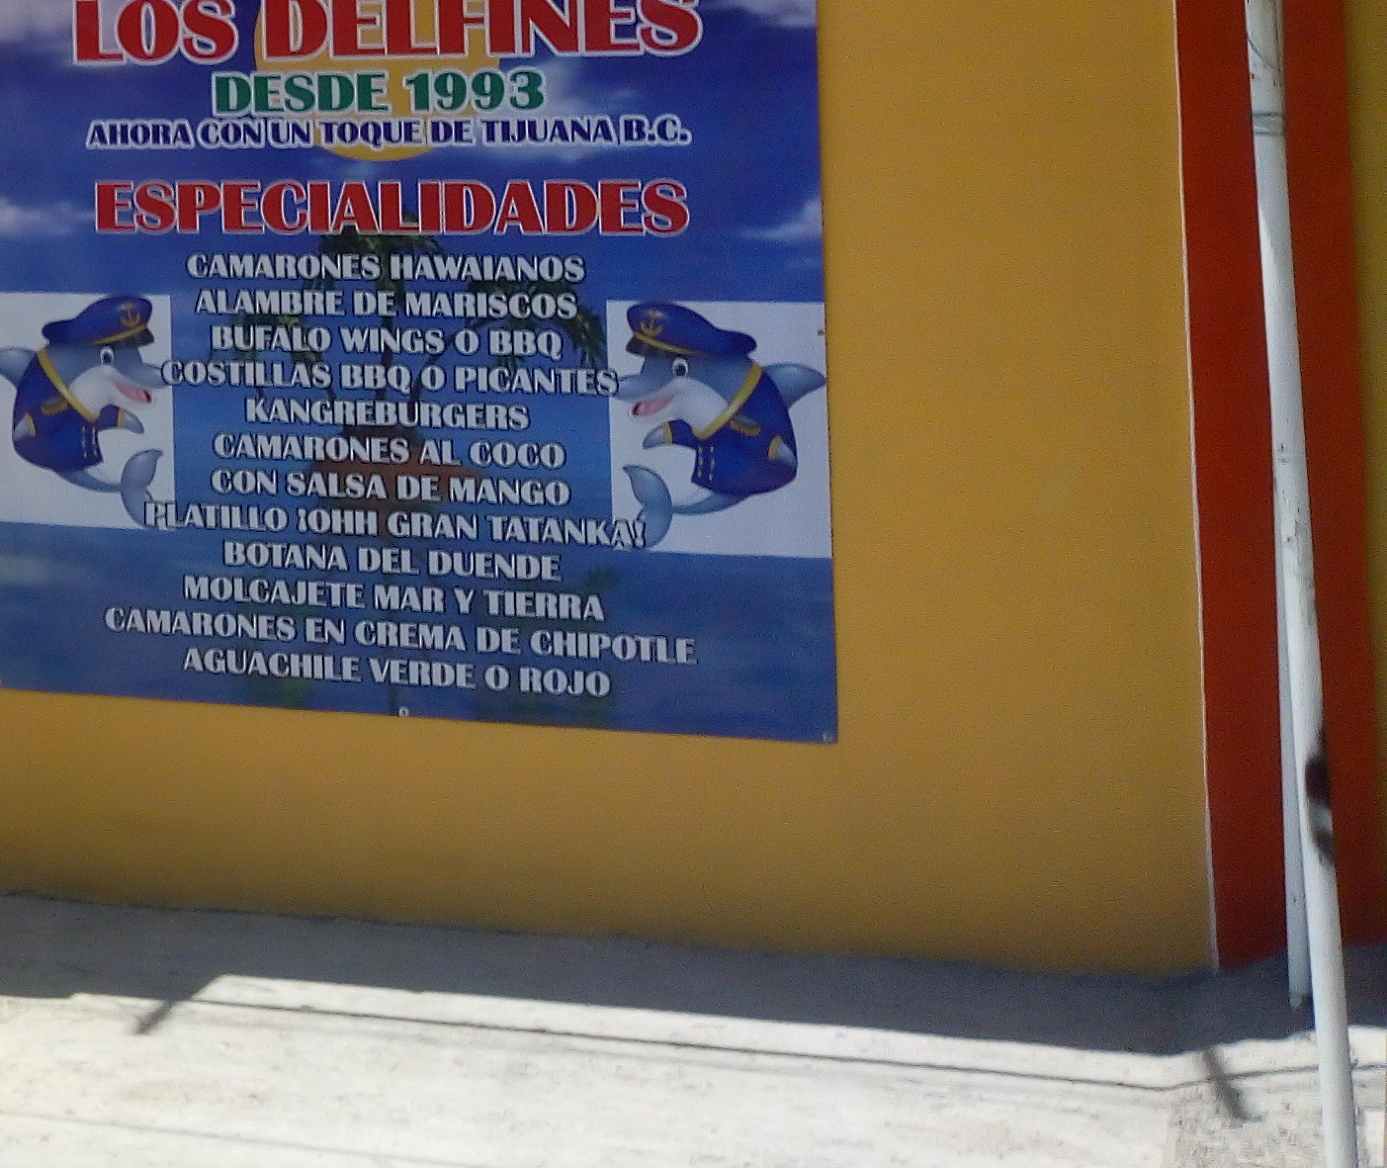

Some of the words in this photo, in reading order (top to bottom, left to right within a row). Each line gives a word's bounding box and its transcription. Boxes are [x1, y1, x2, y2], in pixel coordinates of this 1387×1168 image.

[213, 71, 389, 116] DESDE
[406, 69, 544, 112] 1993
[87, 119, 195, 149] AHORA
[198, 119, 266, 149] CON
[268, 118, 314, 148] UN
[319, 117, 421, 151] TOQUE
[429, 116, 473, 146] DE
[480, 116, 617, 146] TIJUANA
[621, 114, 692, 146] B.C.
[95, 179, 690, 237] ESPECIALIDADES
[187, 253, 381, 281] CAMARONES
[391, 255, 586, 284] HAWAIANOS
[195, 289, 345, 317] ALAMBRE
[353, 291, 395, 318] DE
[404, 291, 579, 320] MARISCOS
[210, 325, 330, 354] BUFALO
[340, 327, 445, 356] WINGS
[455, 328, 479, 356] O
[488, 328, 563, 360] BBQ
[161, 360, 331, 388] COSTILLAS
[340, 363, 411, 393] BBQ
[420, 365, 445, 392] O
[454, 365, 620, 396] PICANTES
[245, 397, 531, 431] KANGREBURGERS
[212, 433, 410, 465] CAMARONES
[419, 438, 460, 467] AL
[468, 440, 567, 470] COCO
[210, 468, 278, 497] CON
[286, 471, 387, 501] SALSA
[396, 475, 442, 502] DE
[449, 475, 571, 507] MANGO
[144, 501, 288, 531] PLATILLO
[386, 511, 476, 540] GRAN
[486, 515, 646, 550] TATANKA!
[223, 541, 348, 571] BOTANA
[358, 547, 420, 575] DEL
[429, 549, 562, 582] DUENDE
[184, 575, 365, 609] MOLCAJETE
[374, 585, 444, 613] MAR
[454, 588, 475, 614] Y
[483, 590, 605, 622] TIERRA
[105, 607, 295, 642] CAMARONES
[306, 617, 345, 645] EN
[355, 621, 466, 651] CREMA
[477, 626, 521, 655] DE
[530, 630, 698, 665] CHIPOTLE
[184, 648, 361, 682] AGUACHILE
[369, 658, 476, 689] VERDE
[484, 665, 509, 692] O
[519, 667, 611, 697] ROJO
